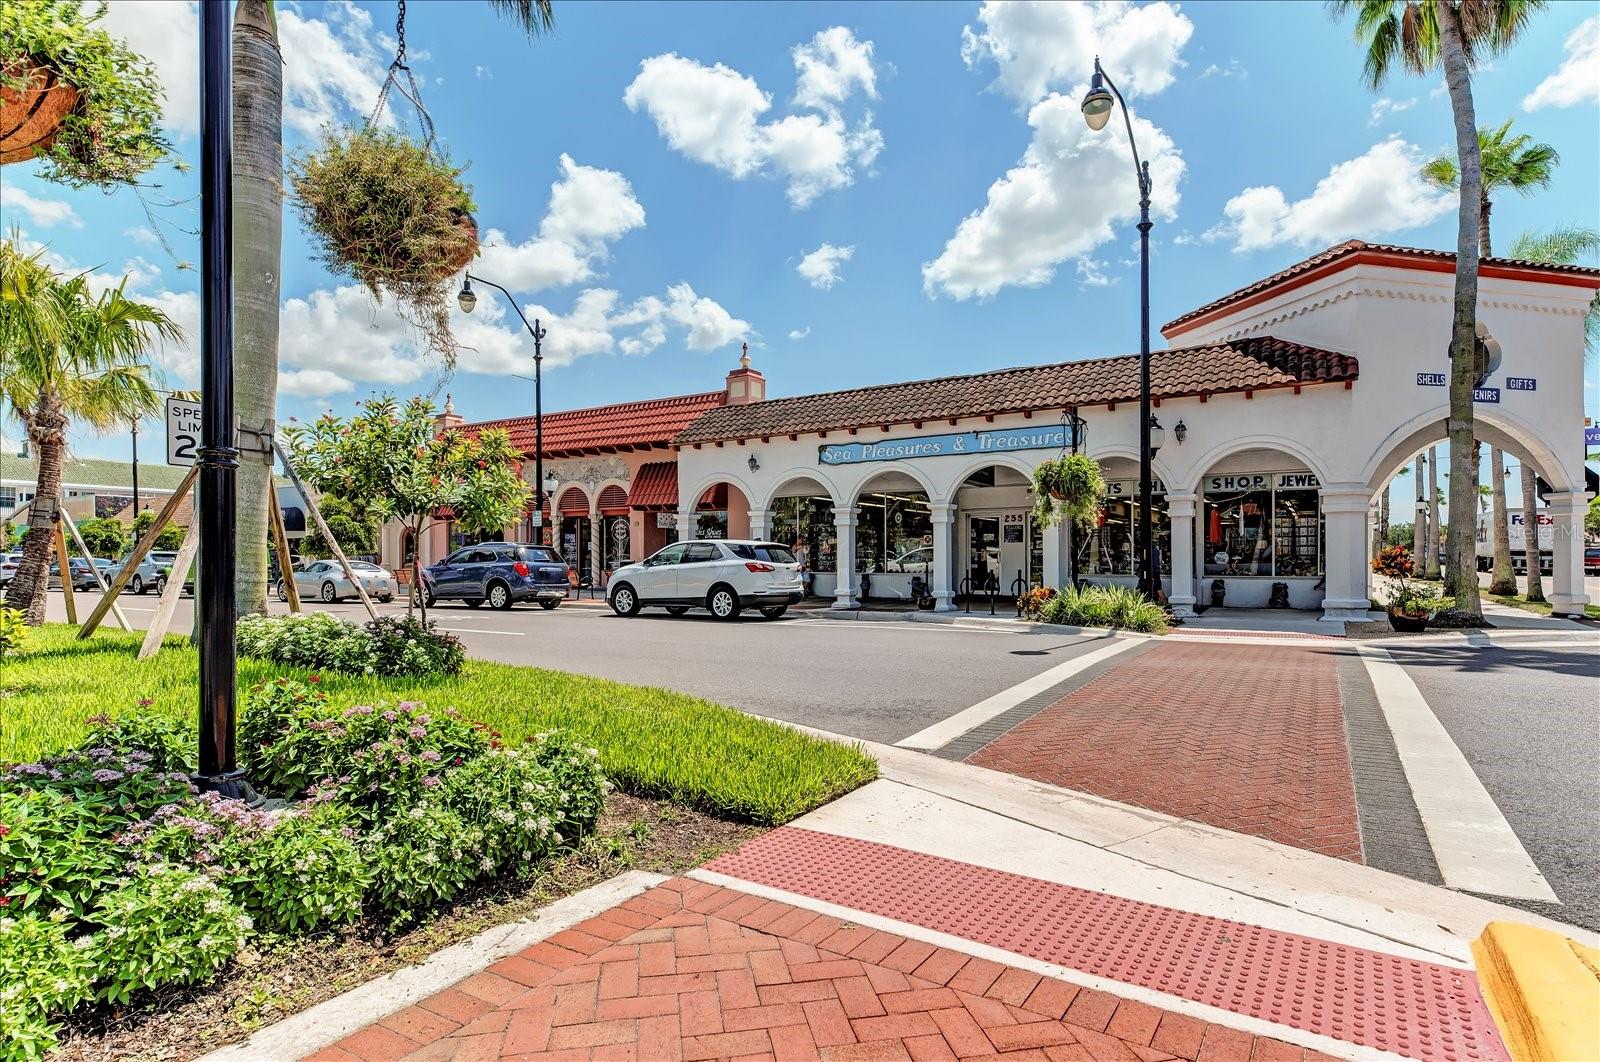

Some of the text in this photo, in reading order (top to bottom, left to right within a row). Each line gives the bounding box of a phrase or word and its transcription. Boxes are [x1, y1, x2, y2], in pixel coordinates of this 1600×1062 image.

[1417, 374, 1445, 385] SHELLS
[1510, 379, 1533, 390] GIFTS
[175, 435, 197, 458] 2
[823, 446, 852, 462] Sea
[862, 443, 942, 459] Pleasures
[953, 436, 966, 451] &
[1211, 475, 1264, 490] SHOP
[1004, 514, 1023, 522] 255
